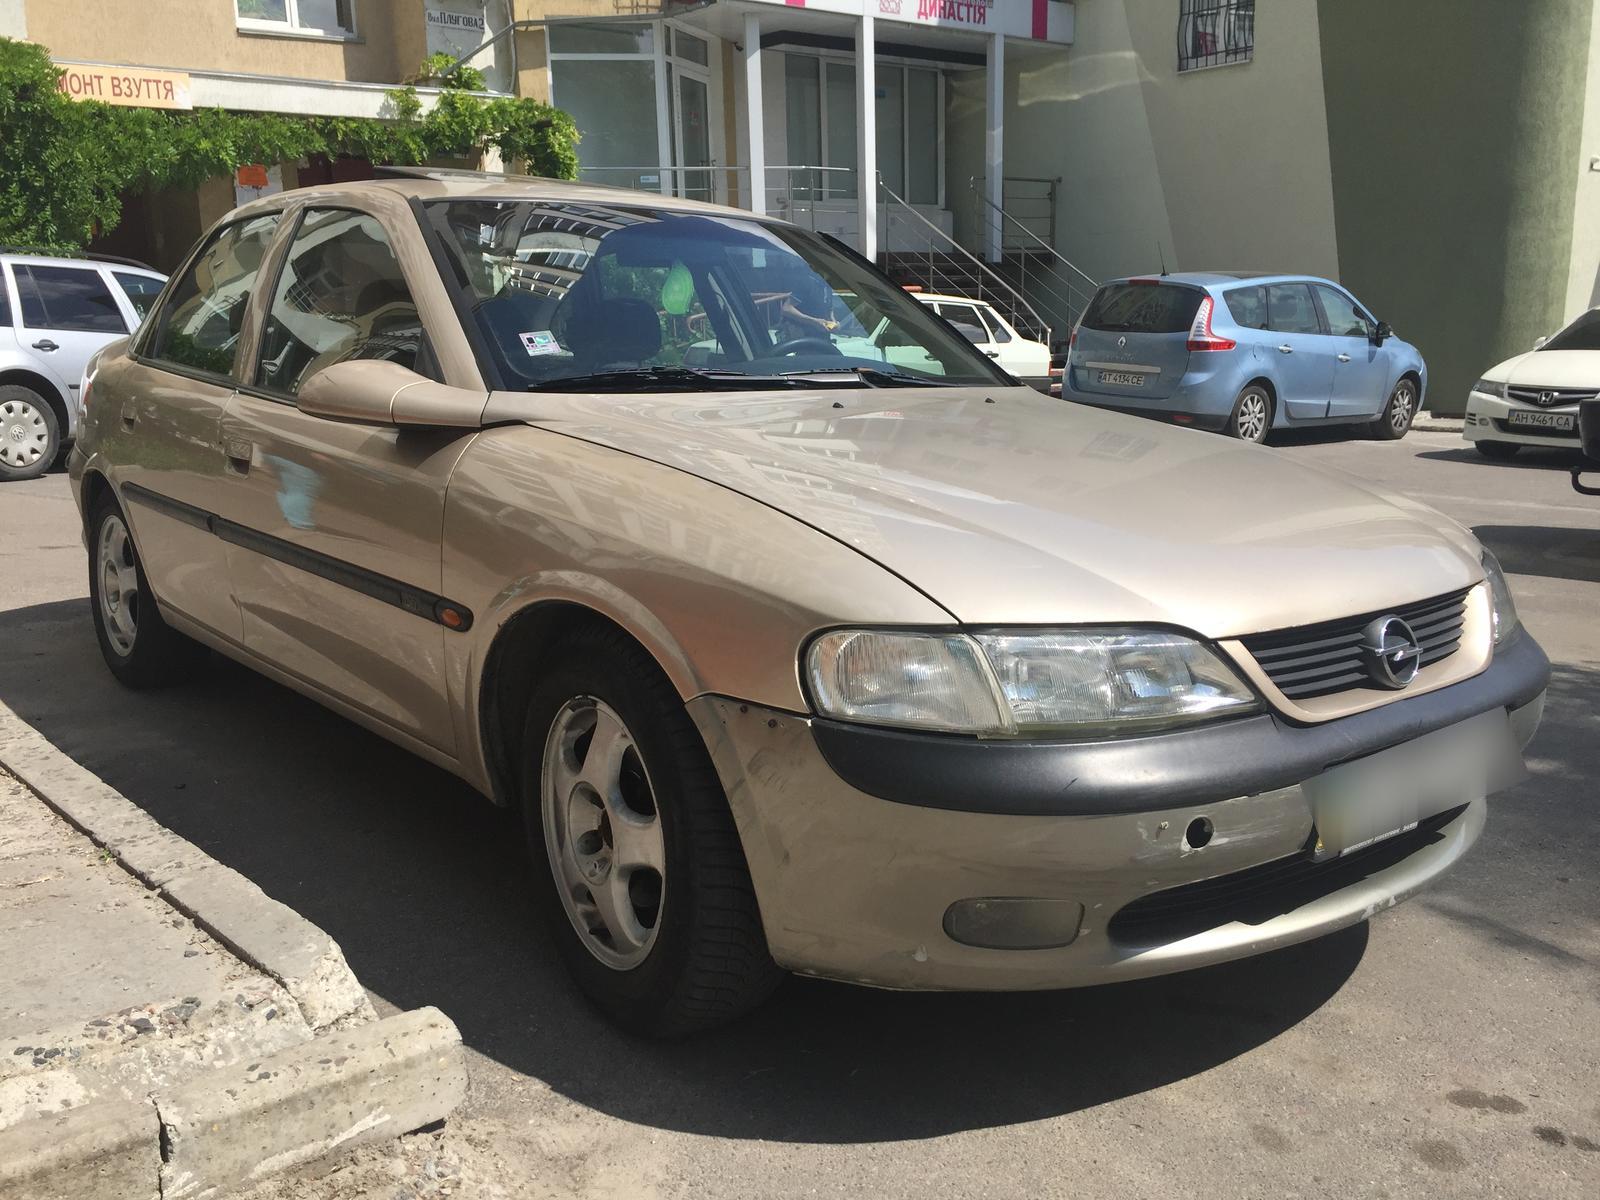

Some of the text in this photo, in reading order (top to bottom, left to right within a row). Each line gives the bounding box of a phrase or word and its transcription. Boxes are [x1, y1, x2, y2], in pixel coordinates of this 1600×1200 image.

[917, 0, 986, 24] ДИНАСТІЯ
[111, 76, 174, 100] ВЗУТТЯ
[1530, 414, 1553, 425] 9461
